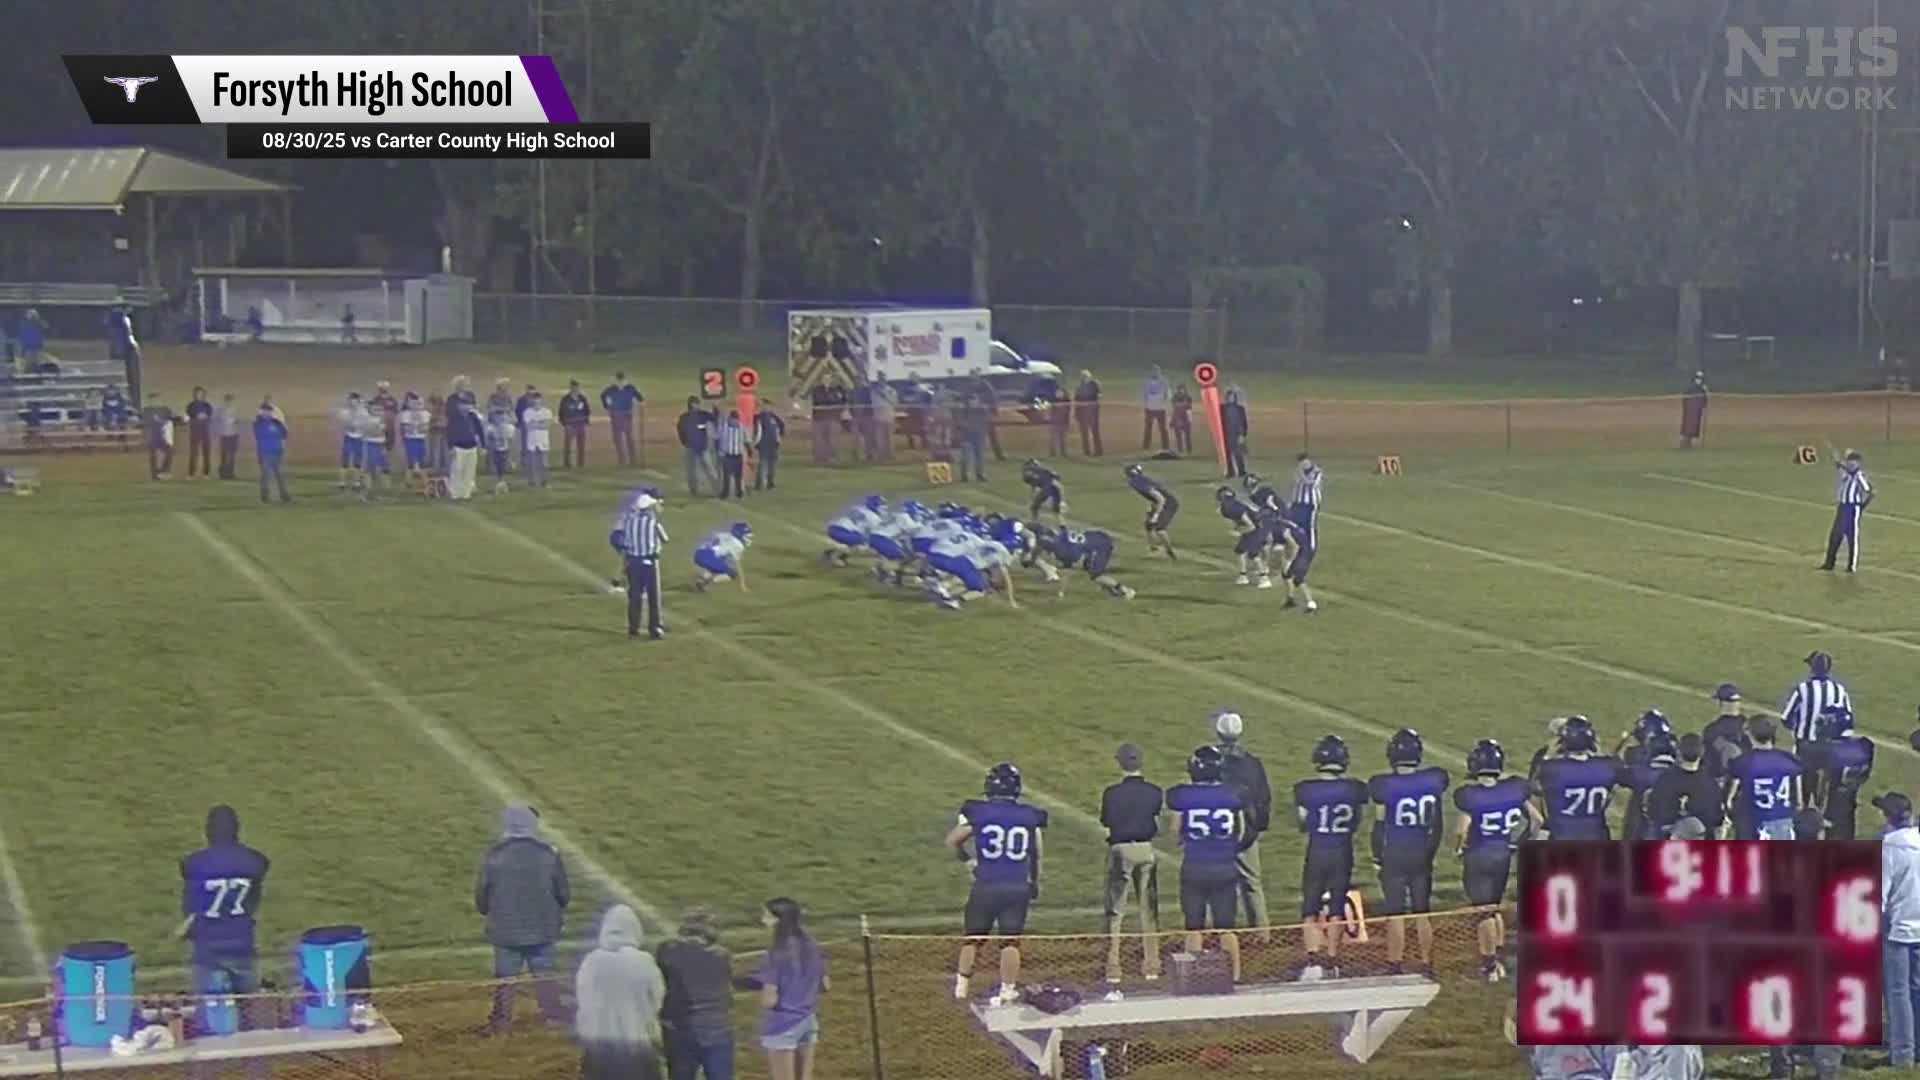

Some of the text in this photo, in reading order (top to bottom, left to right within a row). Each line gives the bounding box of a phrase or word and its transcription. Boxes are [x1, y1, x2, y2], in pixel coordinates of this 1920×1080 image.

[1560, 787, 1608, 817] 70
[1753, 778, 1791, 810] 54
[1187, 808, 1235, 840] 53
[1316, 804, 1352, 830] 12
[980, 824, 1029, 861] 30
[205, 878, 250, 918] 77
